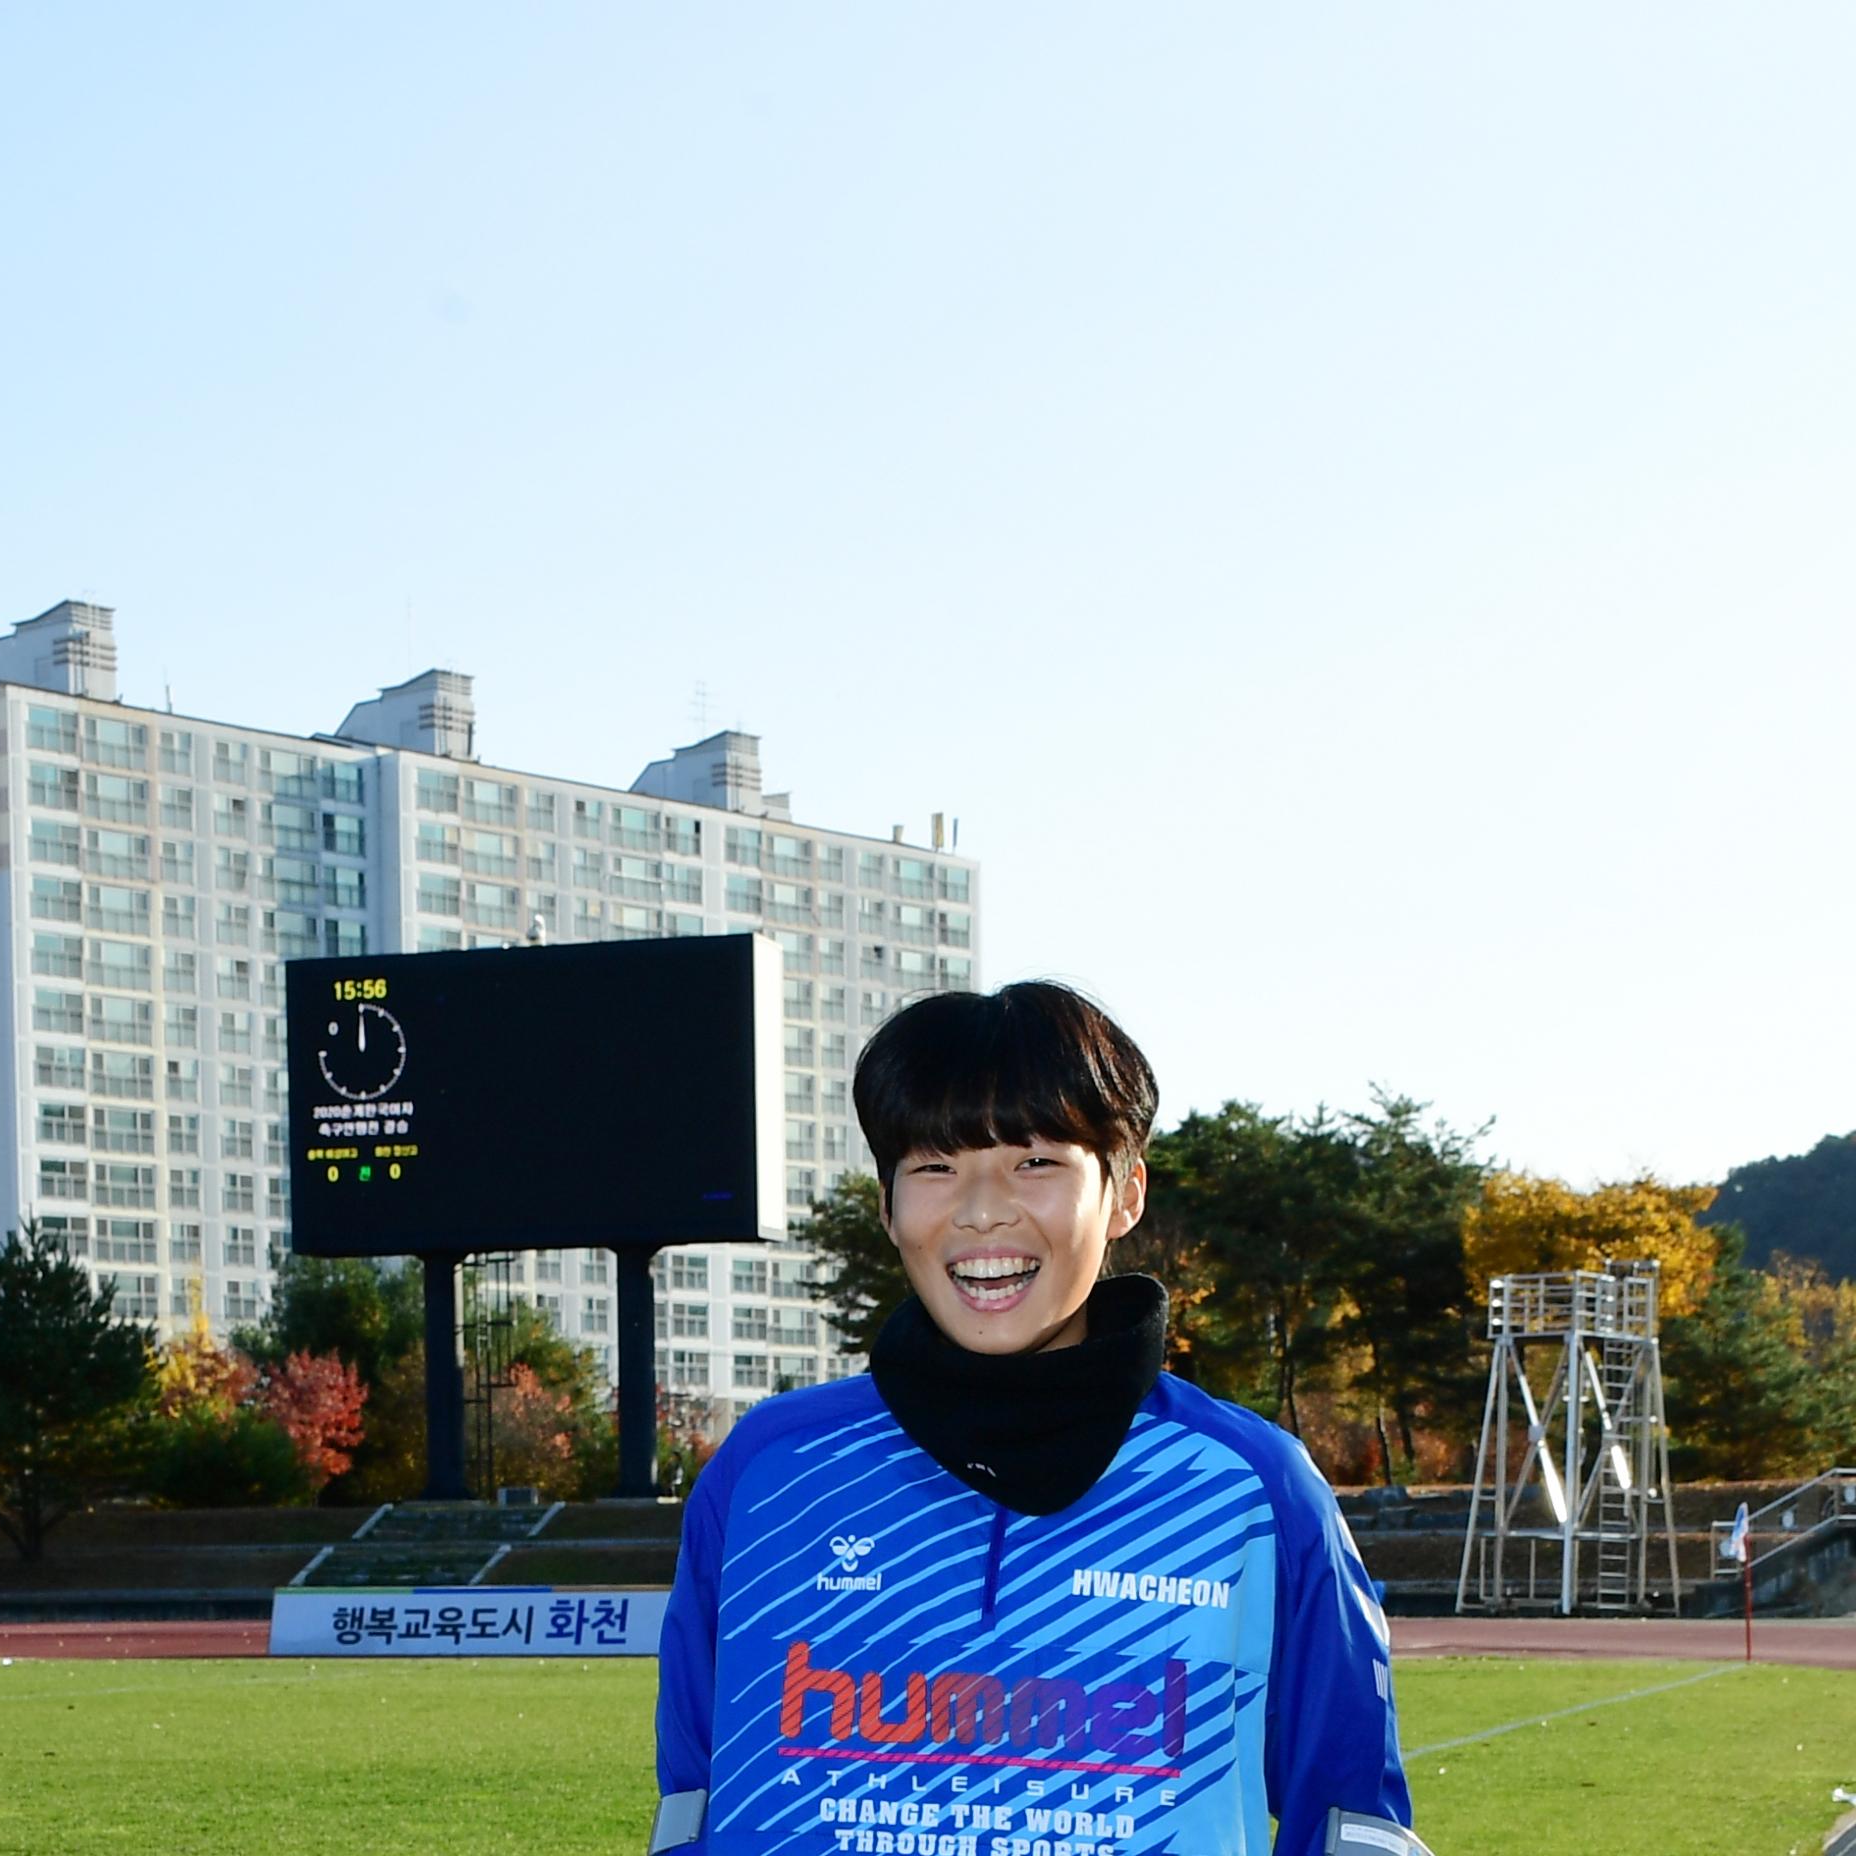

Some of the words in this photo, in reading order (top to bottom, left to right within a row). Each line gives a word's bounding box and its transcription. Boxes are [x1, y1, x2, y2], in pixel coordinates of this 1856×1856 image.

[334, 978, 387, 1001] 15:56
[327, 1165, 339, 1182] 0
[389, 1163, 401, 1180] 0
[816, 1573, 882, 1592] hummel
[1072, 1569, 1231, 1609] HWACHEON
[332, 1605, 535, 1646] 행복교육도시
[545, 1598, 630, 1645] 화천
[779, 1640, 1188, 1759] hummel
[781, 1769, 1177, 1807] ATHLEISURE
[819, 1798, 940, 1828] CHANGE
[950, 1804, 1013, 1832] THE
[1026, 1808, 1135, 1840] WORLD
